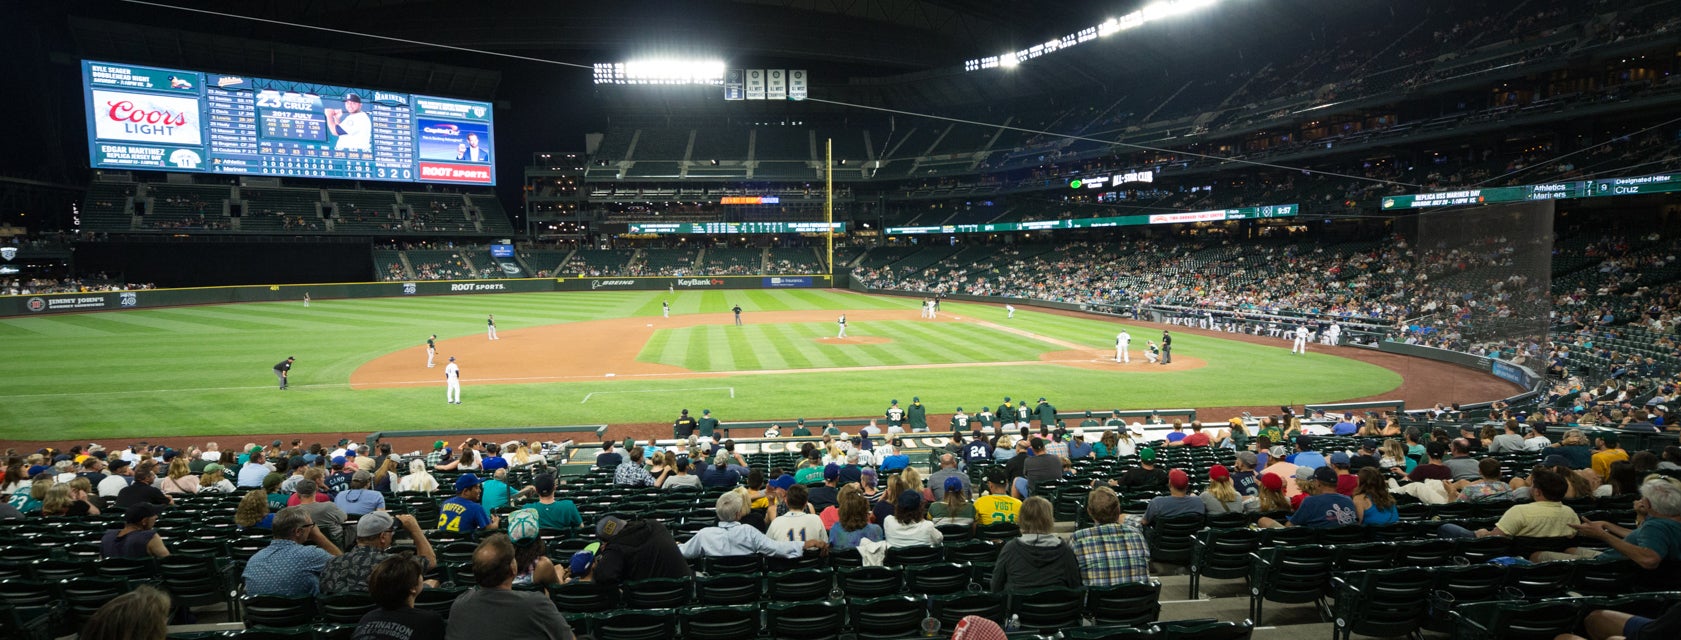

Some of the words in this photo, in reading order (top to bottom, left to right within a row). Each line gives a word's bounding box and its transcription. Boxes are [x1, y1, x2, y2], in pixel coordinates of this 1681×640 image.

[256, 92, 282, 108] 23
[374, 92, 406, 104] MARINERS
[284, 102, 312, 111] CRUZ
[107, 100, 188, 126] Coors
[125, 123, 174, 136] LIGHT
[102, 145, 128, 154] EDGAR
[128, 146, 166, 156] MARTINEZ
[378, 168, 386, 178] 3
[391, 169, 398, 178] 2
[403, 169, 411, 179] 0
[422, 166, 453, 177] ROOT
[1138, 171, 1152, 182] CLUB
[1277, 206, 1292, 215] 9:57
[890, 413, 901, 421] 30
[958, 418, 966, 426] 15
[970, 446, 986, 457] 24
[329, 476, 345, 486] CANO
[994, 501, 1014, 511] VOGT
[437, 513, 462, 532] 24
[786, 527, 806, 542] 11
